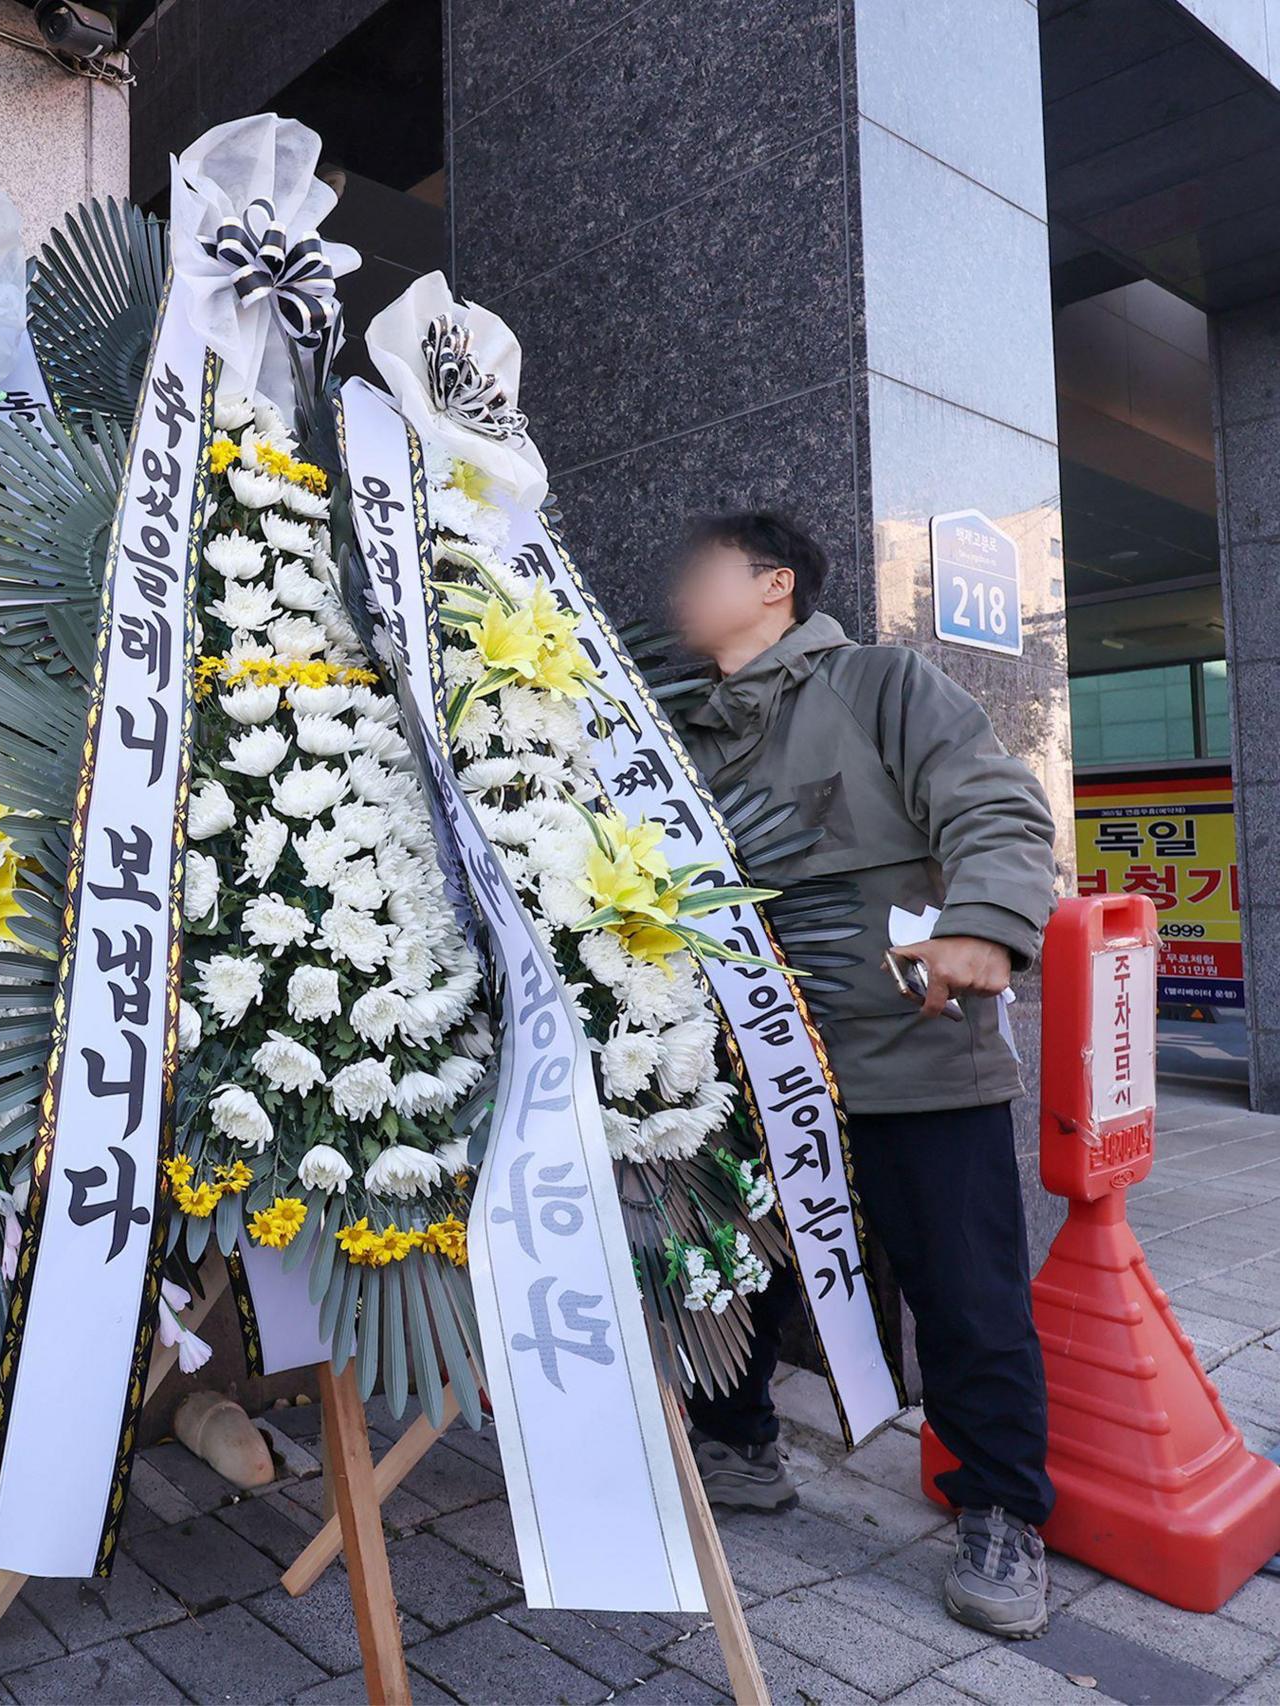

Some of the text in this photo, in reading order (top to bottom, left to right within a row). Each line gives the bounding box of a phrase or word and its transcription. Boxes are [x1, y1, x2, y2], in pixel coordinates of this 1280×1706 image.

[952, 576, 1007, 636] 218
[1095, 820, 1197, 858] 독일
[63, 825, 162, 1265] 보냅니다
[767, 1066, 863, 1302] 등지는가
